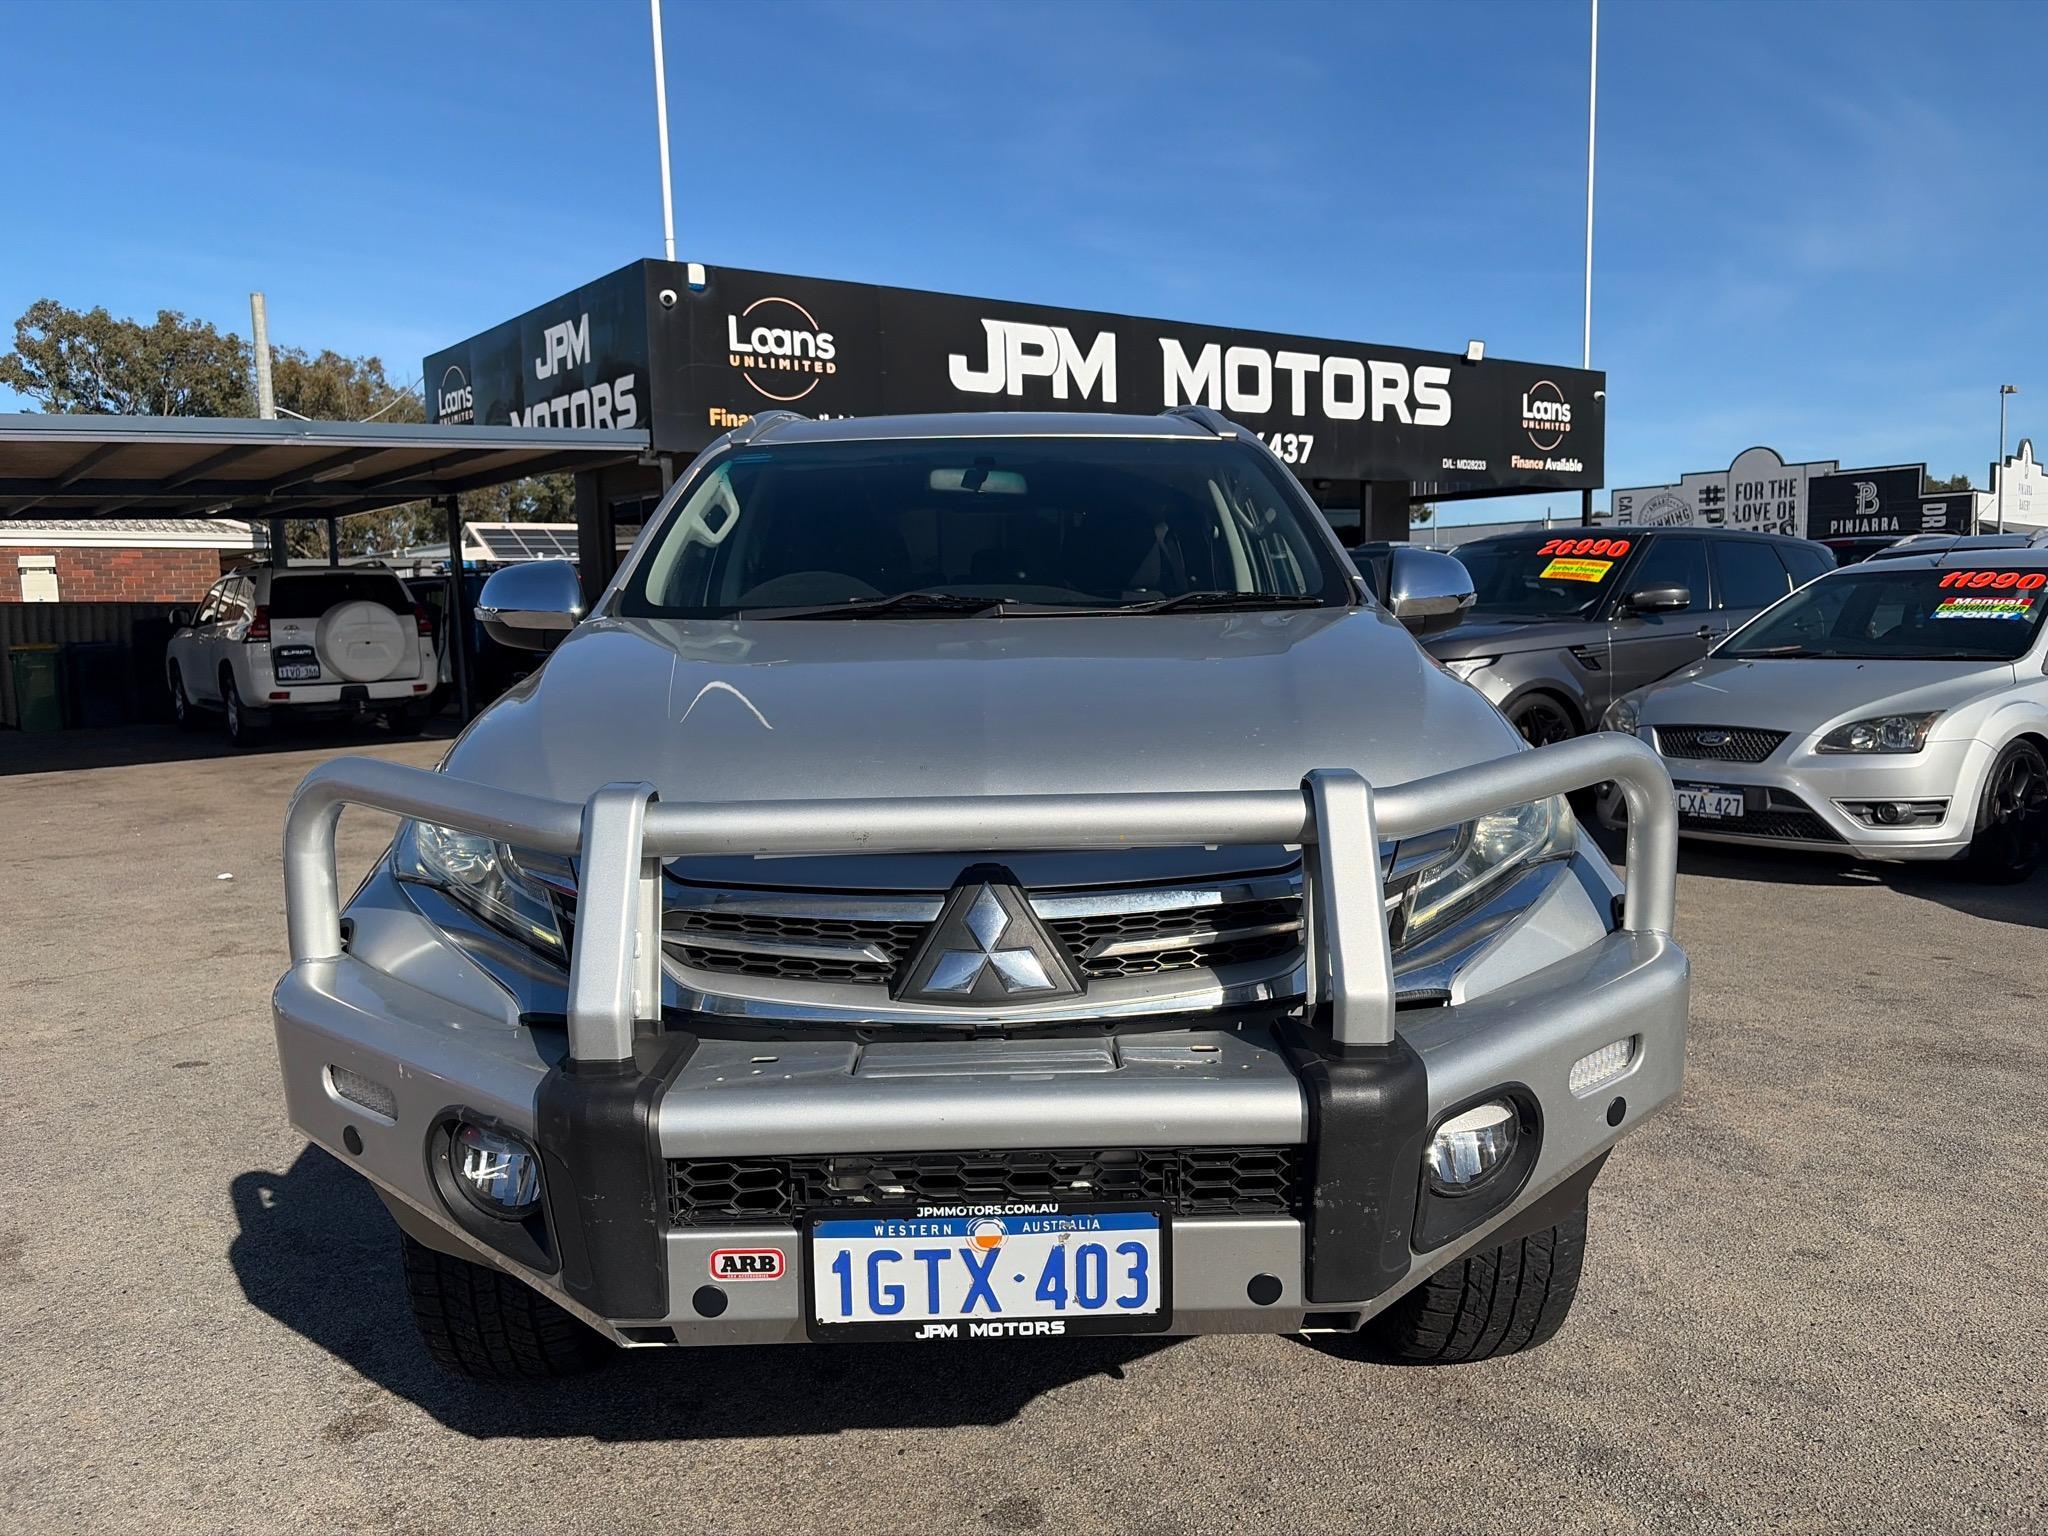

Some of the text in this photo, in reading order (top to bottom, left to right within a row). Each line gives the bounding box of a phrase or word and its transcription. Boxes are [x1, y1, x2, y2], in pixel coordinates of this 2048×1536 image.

[535, 312, 591, 380] JPM
[727, 314, 837, 360] Loans
[729, 354, 837, 374] UNLIMITED
[948, 318, 1452, 427] JPM MOTORS
[438, 385, 473, 417] Loans
[1522, 393, 1571, 422] Loans
[708, 407, 755, 427] Fina
[1522, 419, 1571, 432] UNLIMITED
[1256, 432, 1314, 464] 437
[1511, 455, 1583, 472] Finance Available
[1735, 478, 1797, 501] FOR THE
[1618, 496, 1633, 526] CATE
[1734, 502, 1771, 524] LOVE
[1830, 516, 1900, 535] PINJARRA
[1536, 538, 1631, 558] 26990
[1938, 571, 2047, 589] 11990
[1953, 597, 2024, 605] Manual
[1935, 611, 2014, 619] SPORTY
[916, 1202, 1059, 1218] JPMMOTORS.COM.AU
[874, 1218, 1100, 1237] WESTERN AUSTRALIA
[720, 1255, 776, 1273] ARB
[915, 1320, 1066, 1340] JPM MOTORS
